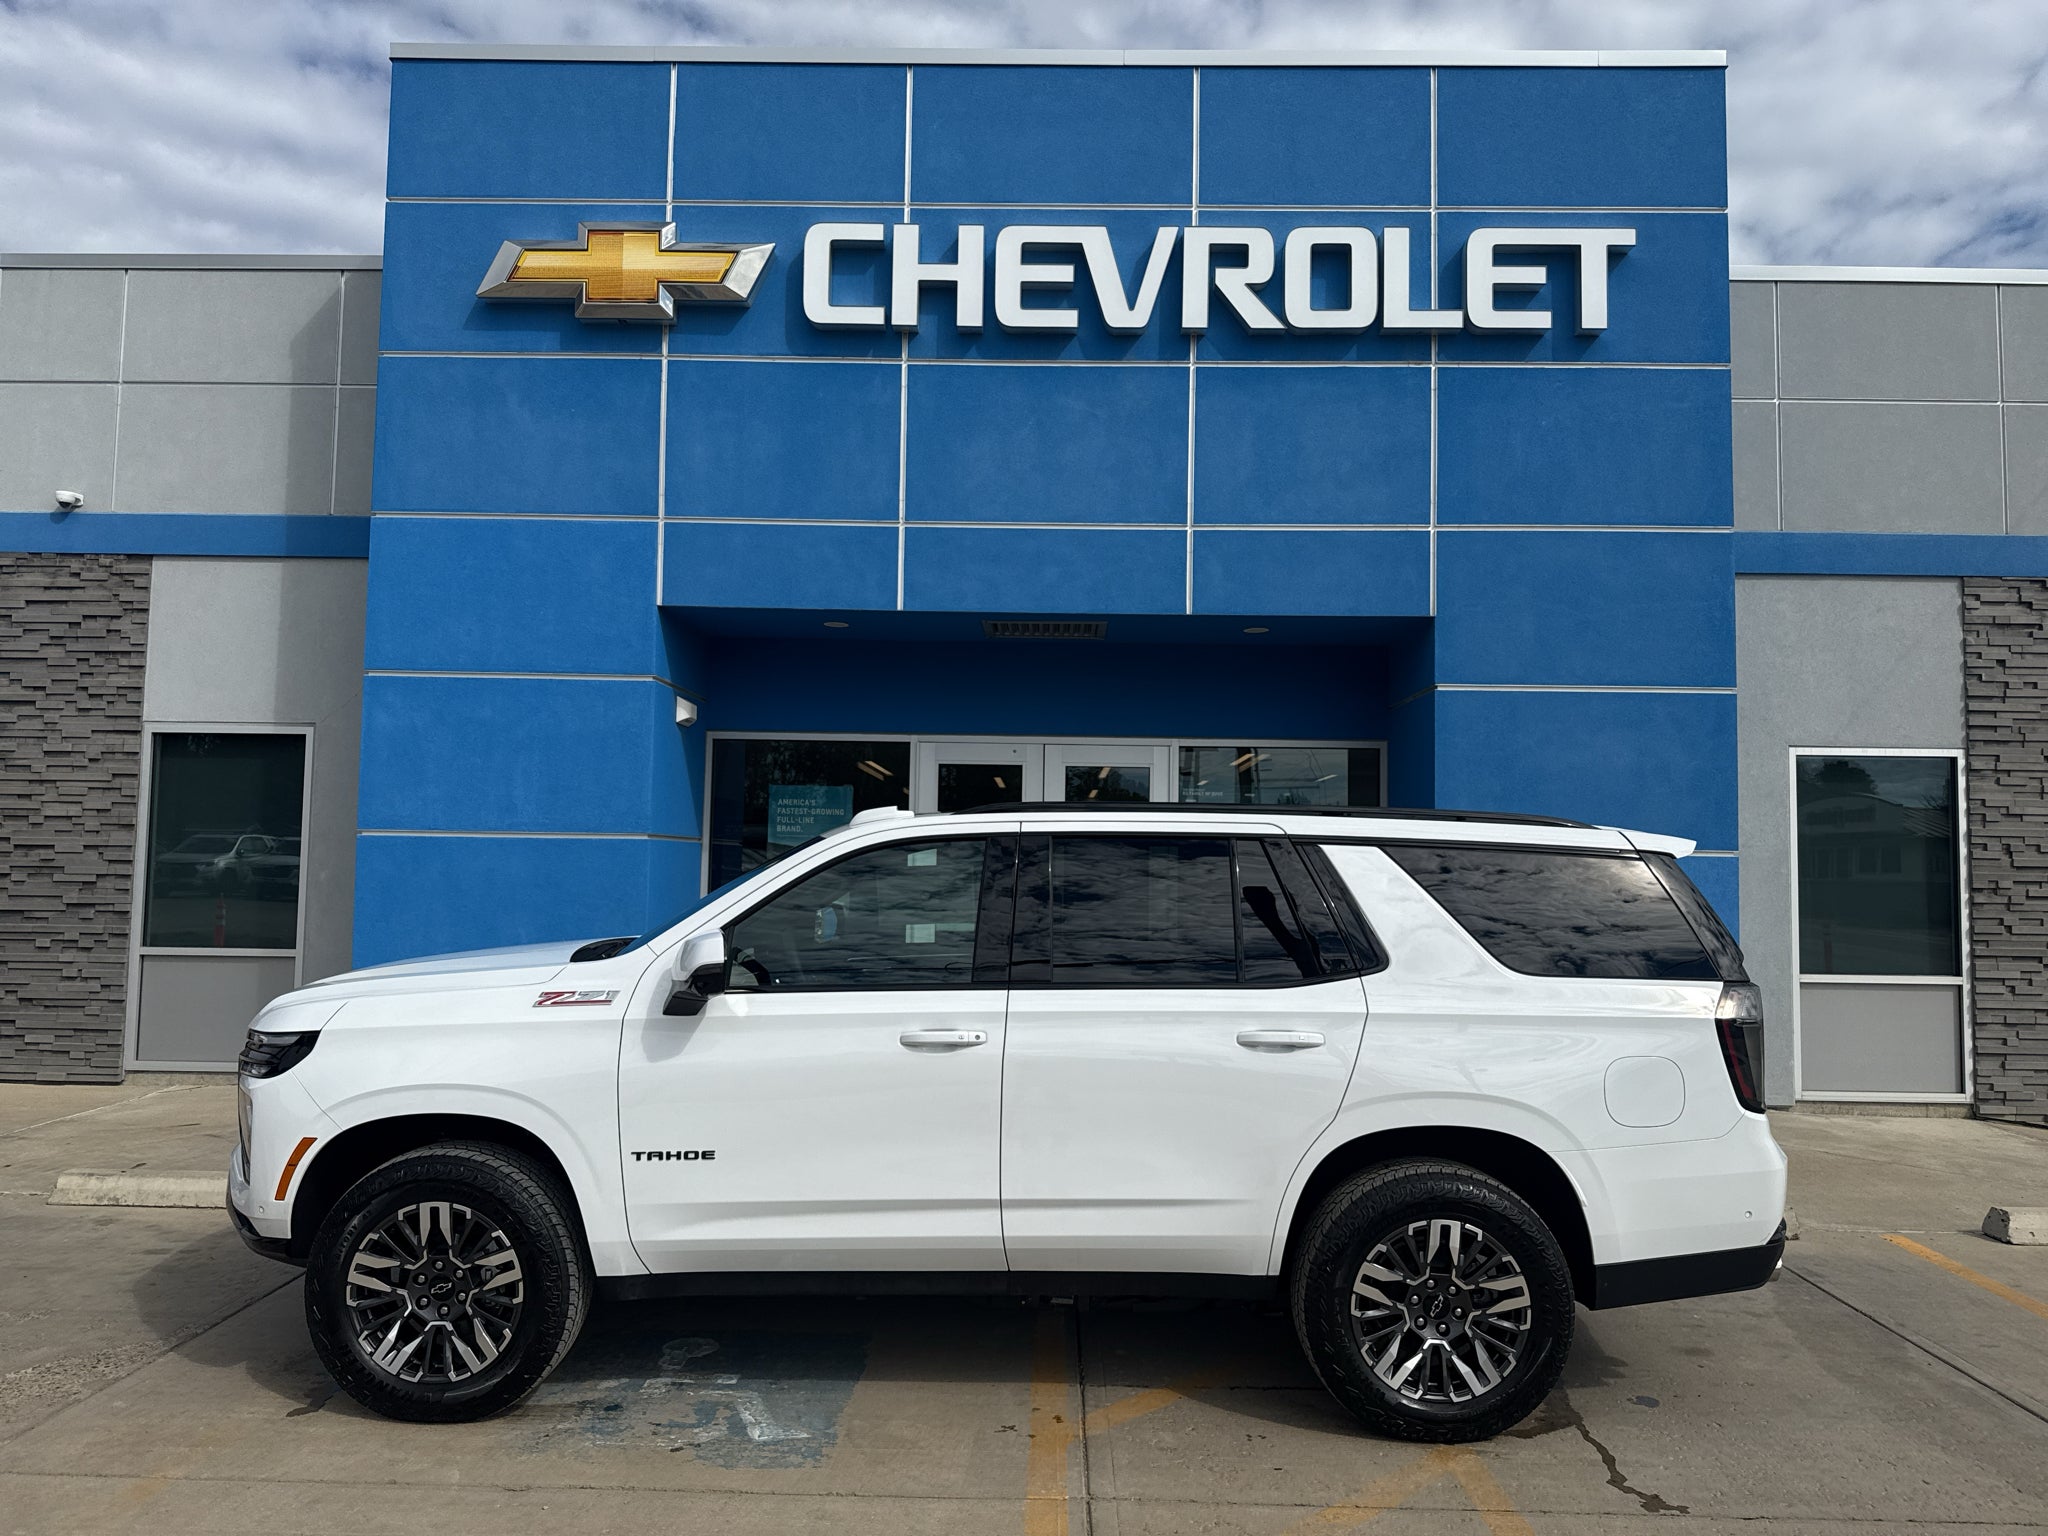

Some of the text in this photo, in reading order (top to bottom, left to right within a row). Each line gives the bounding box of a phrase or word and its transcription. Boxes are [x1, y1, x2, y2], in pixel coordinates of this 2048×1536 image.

[803, 223, 1637, 332] CHEVROLET
[777, 798, 816, 806] AMERICA'S
[777, 807, 845, 816] FASTEST-GROWING
[777, 816, 815, 824] FULL-LINE
[776, 825, 804, 833] BRAND.
[532, 990, 621, 1008] Z71
[631, 1150, 716, 1161] TAHOE
